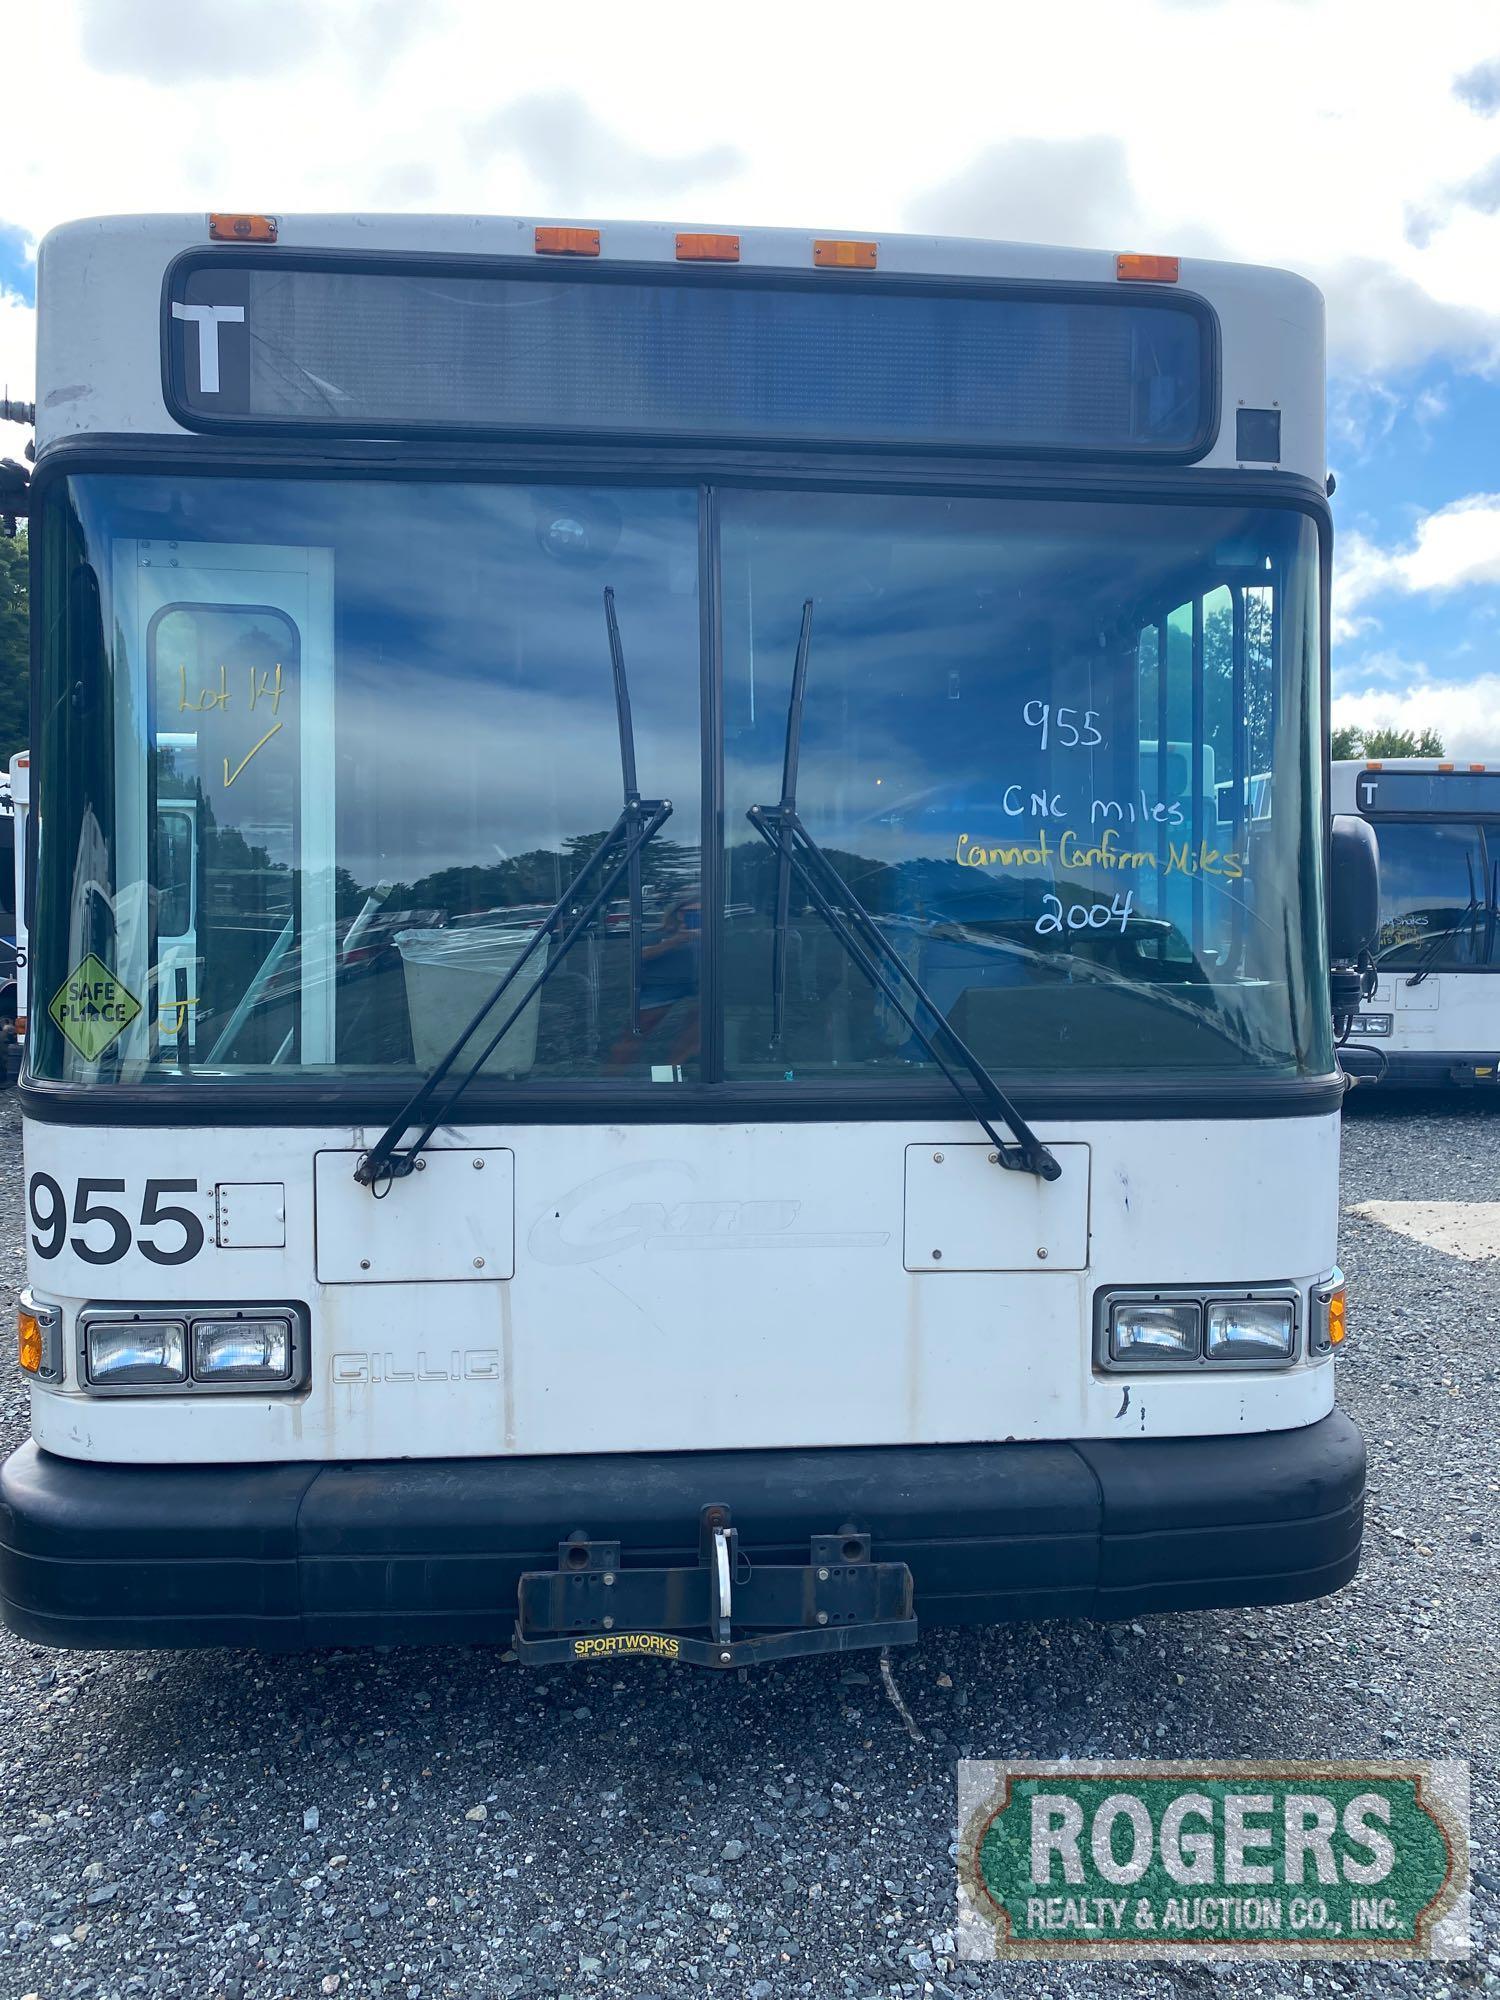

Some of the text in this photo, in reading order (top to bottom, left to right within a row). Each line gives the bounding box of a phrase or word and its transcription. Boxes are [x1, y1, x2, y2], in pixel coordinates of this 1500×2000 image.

[171, 301, 244, 393] T
[178, 663, 233, 713] Lot
[1023, 700, 1102, 750] 955
[1002, 785, 1184, 826] CNC miles
[1361, 782, 1378, 805] T
[956, 829, 1055, 867] Cannot
[1060, 829, 1157, 869] Confirm
[1034, 890, 1133, 934] 2004
[69, 982, 115, 1001] SAFE
[29, 1171, 205, 1265] 955
[331, 1349, 500, 1384] GILLIG
[574, 1634, 679, 1654] SPORTWORKS
